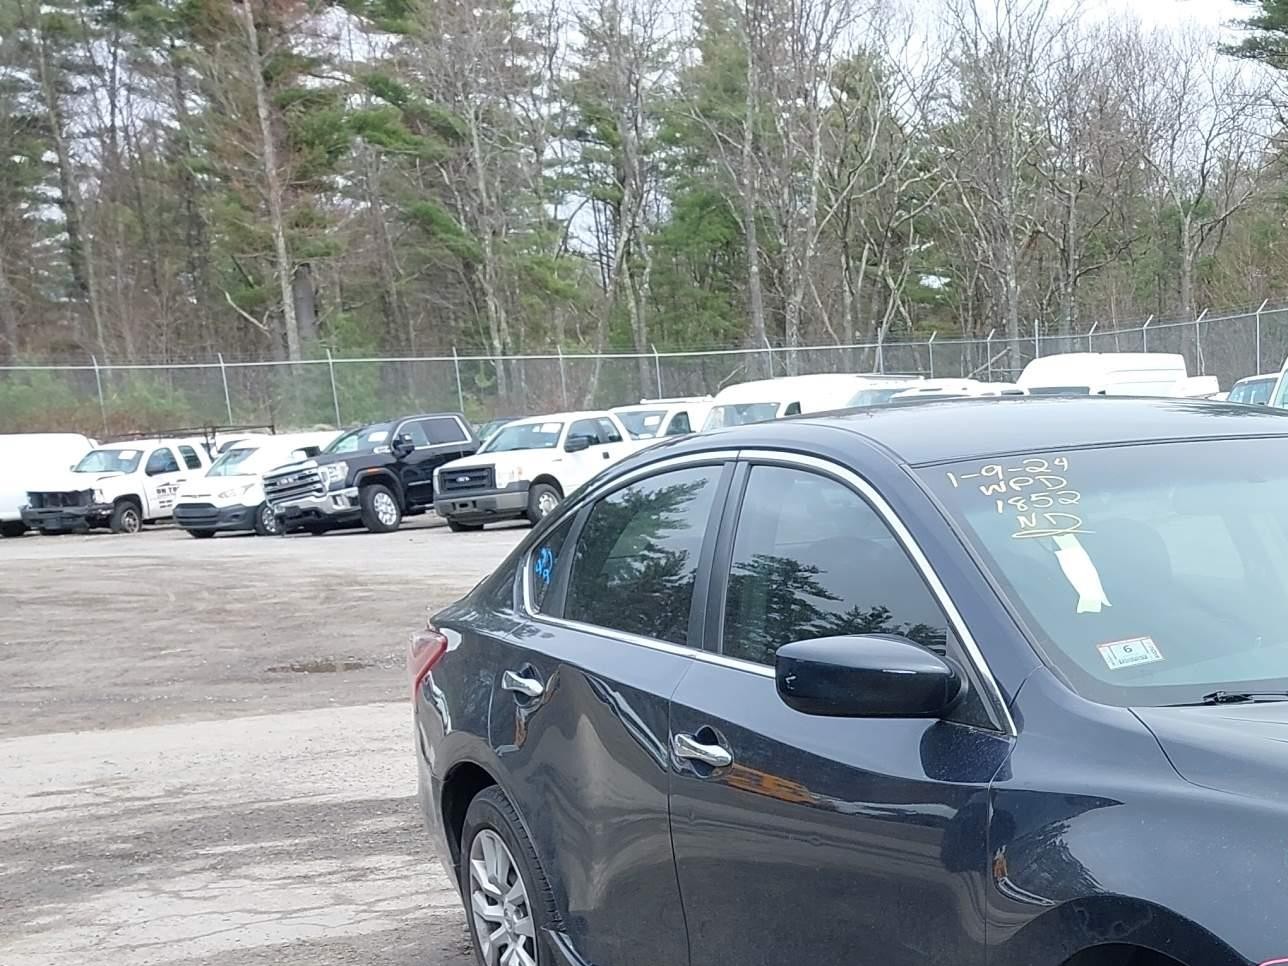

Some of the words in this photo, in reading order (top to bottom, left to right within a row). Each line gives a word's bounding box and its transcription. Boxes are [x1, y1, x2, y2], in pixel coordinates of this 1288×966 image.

[947, 457, 1069, 488] 1-9-24
[995, 490, 1081, 513] 1852
[1123, 645, 1133, 653] 6
